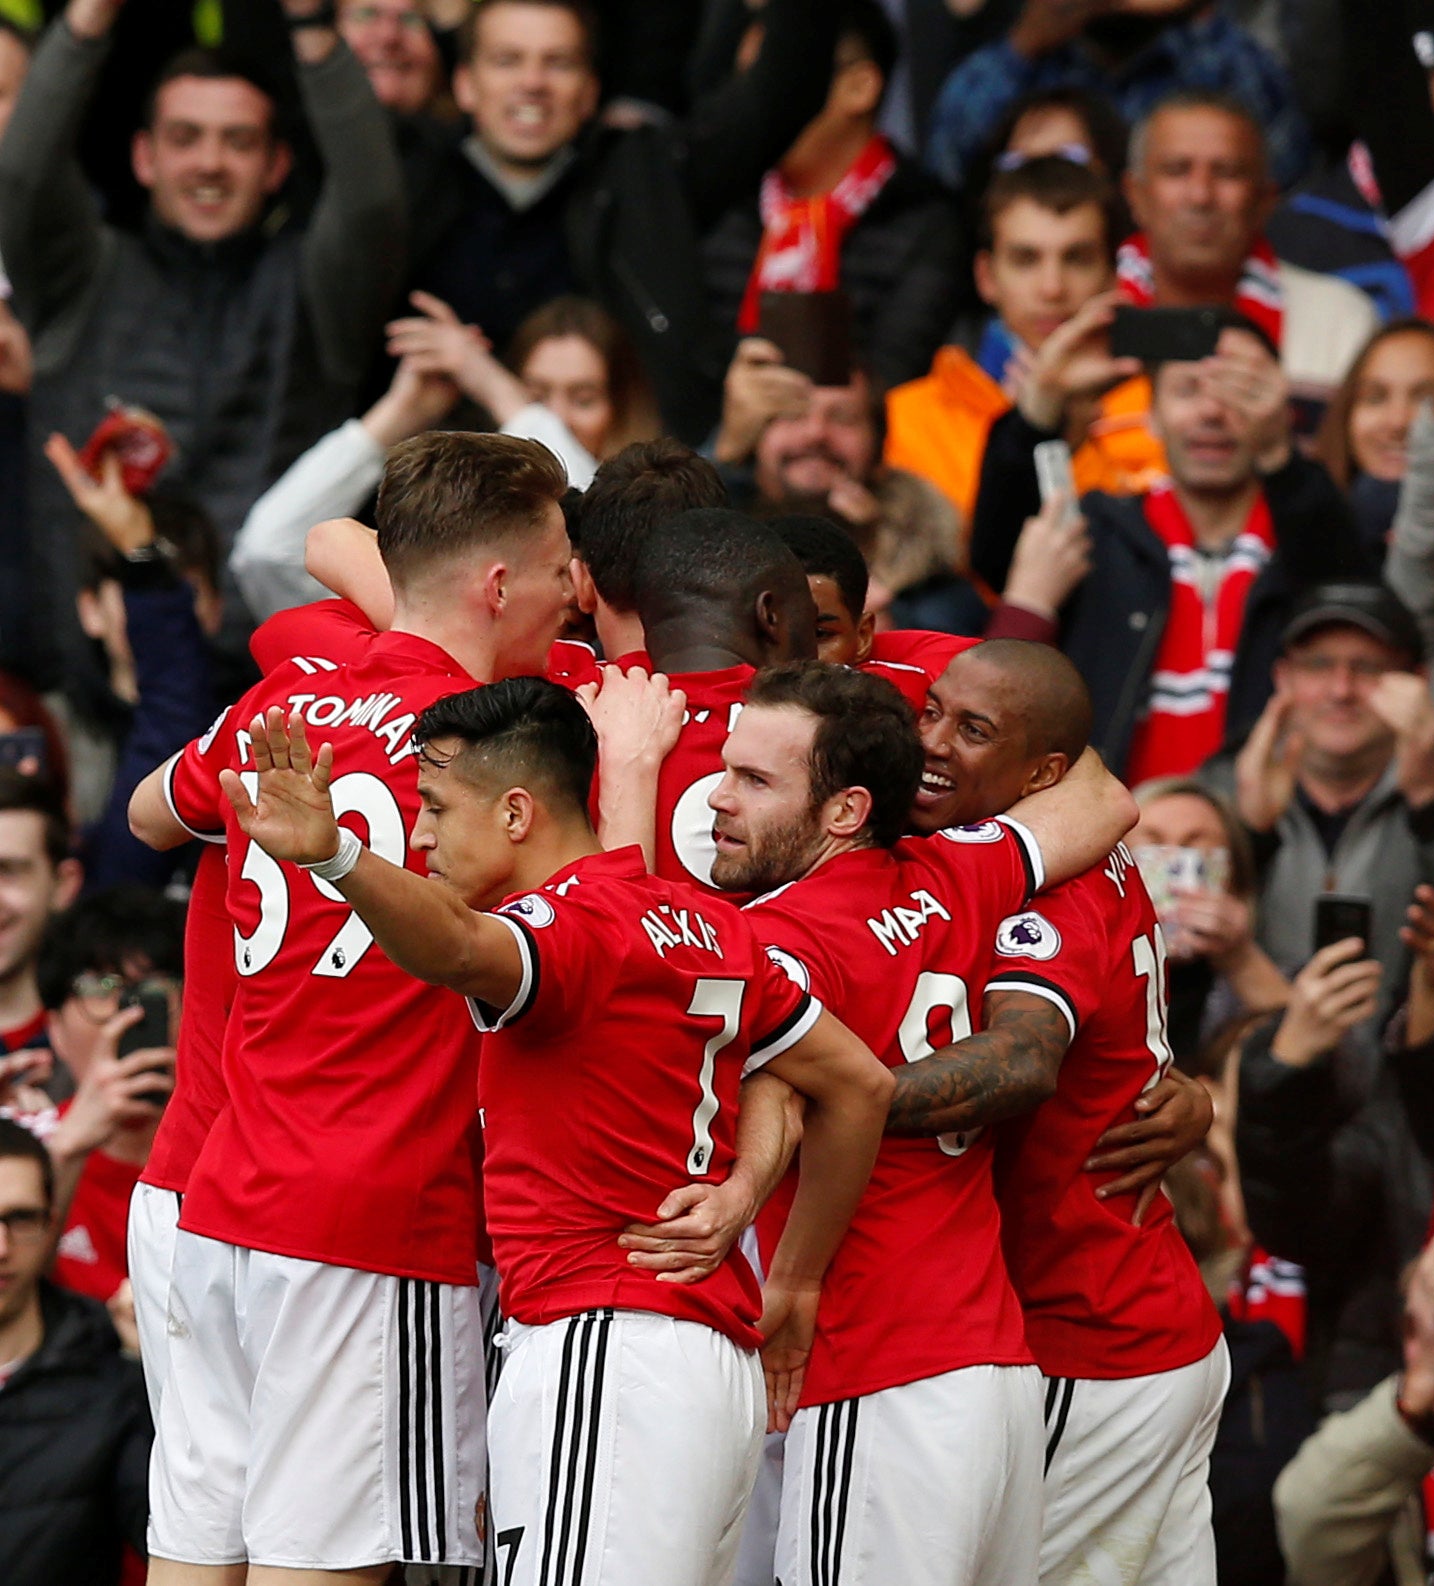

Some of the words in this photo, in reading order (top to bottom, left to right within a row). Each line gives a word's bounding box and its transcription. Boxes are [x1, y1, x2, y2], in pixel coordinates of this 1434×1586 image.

[234, 772, 407, 977] 39
[687, 979, 745, 1175] 7
[497, 1526, 525, 1586] 7
